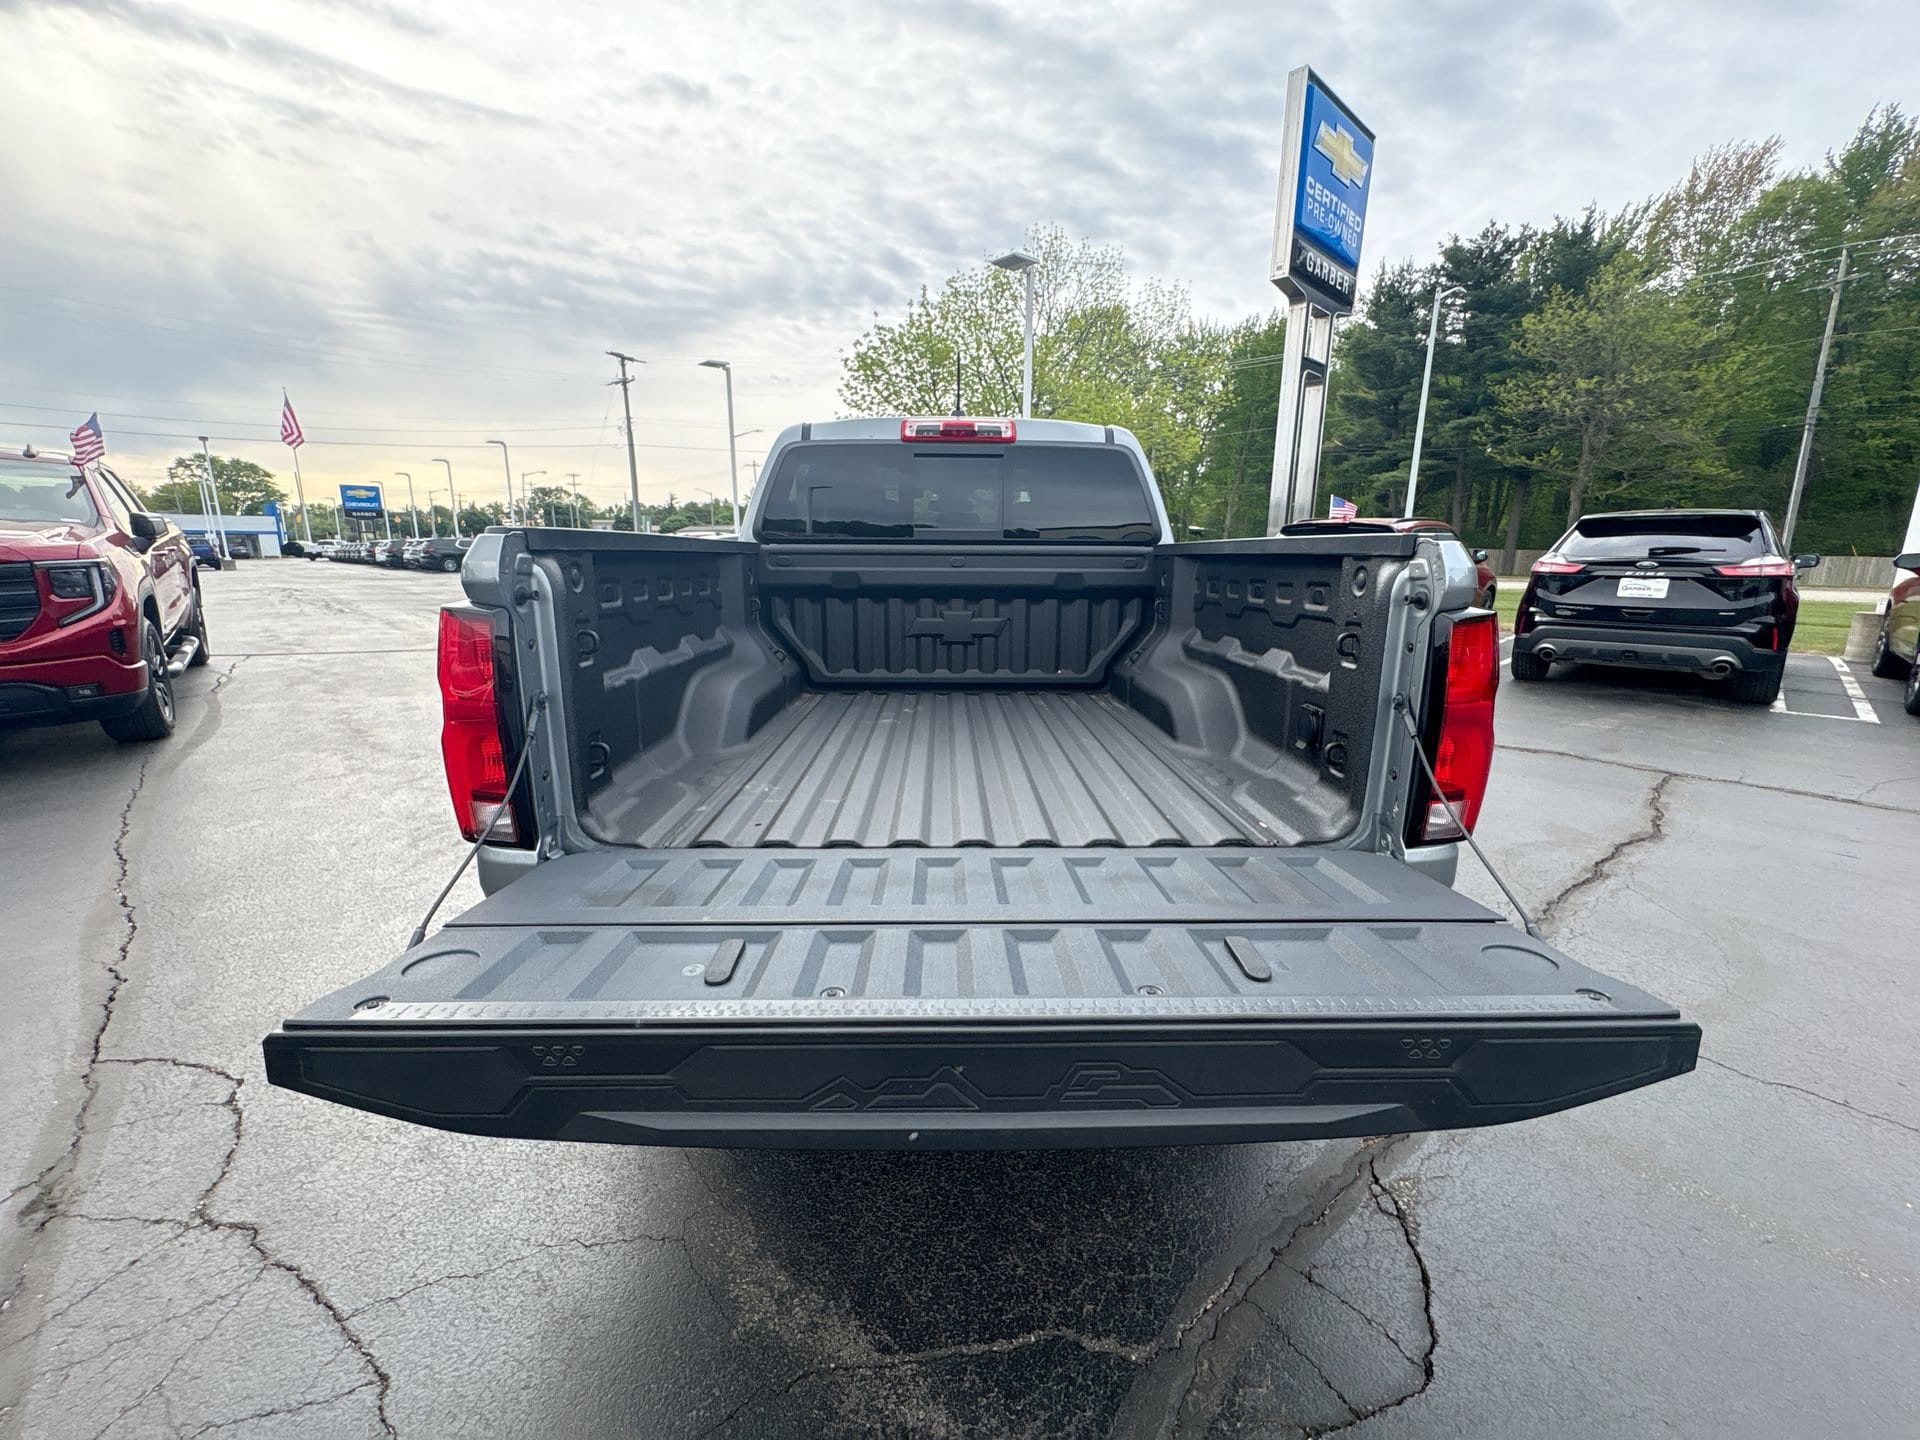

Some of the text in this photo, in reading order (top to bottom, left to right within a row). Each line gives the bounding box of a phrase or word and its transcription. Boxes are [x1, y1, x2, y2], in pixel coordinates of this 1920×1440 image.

[1306, 175, 1362, 233] CERTIFIED
[1307, 198, 1358, 248] PRE-OWNED
[1306, 252, 1350, 295] GARBER
